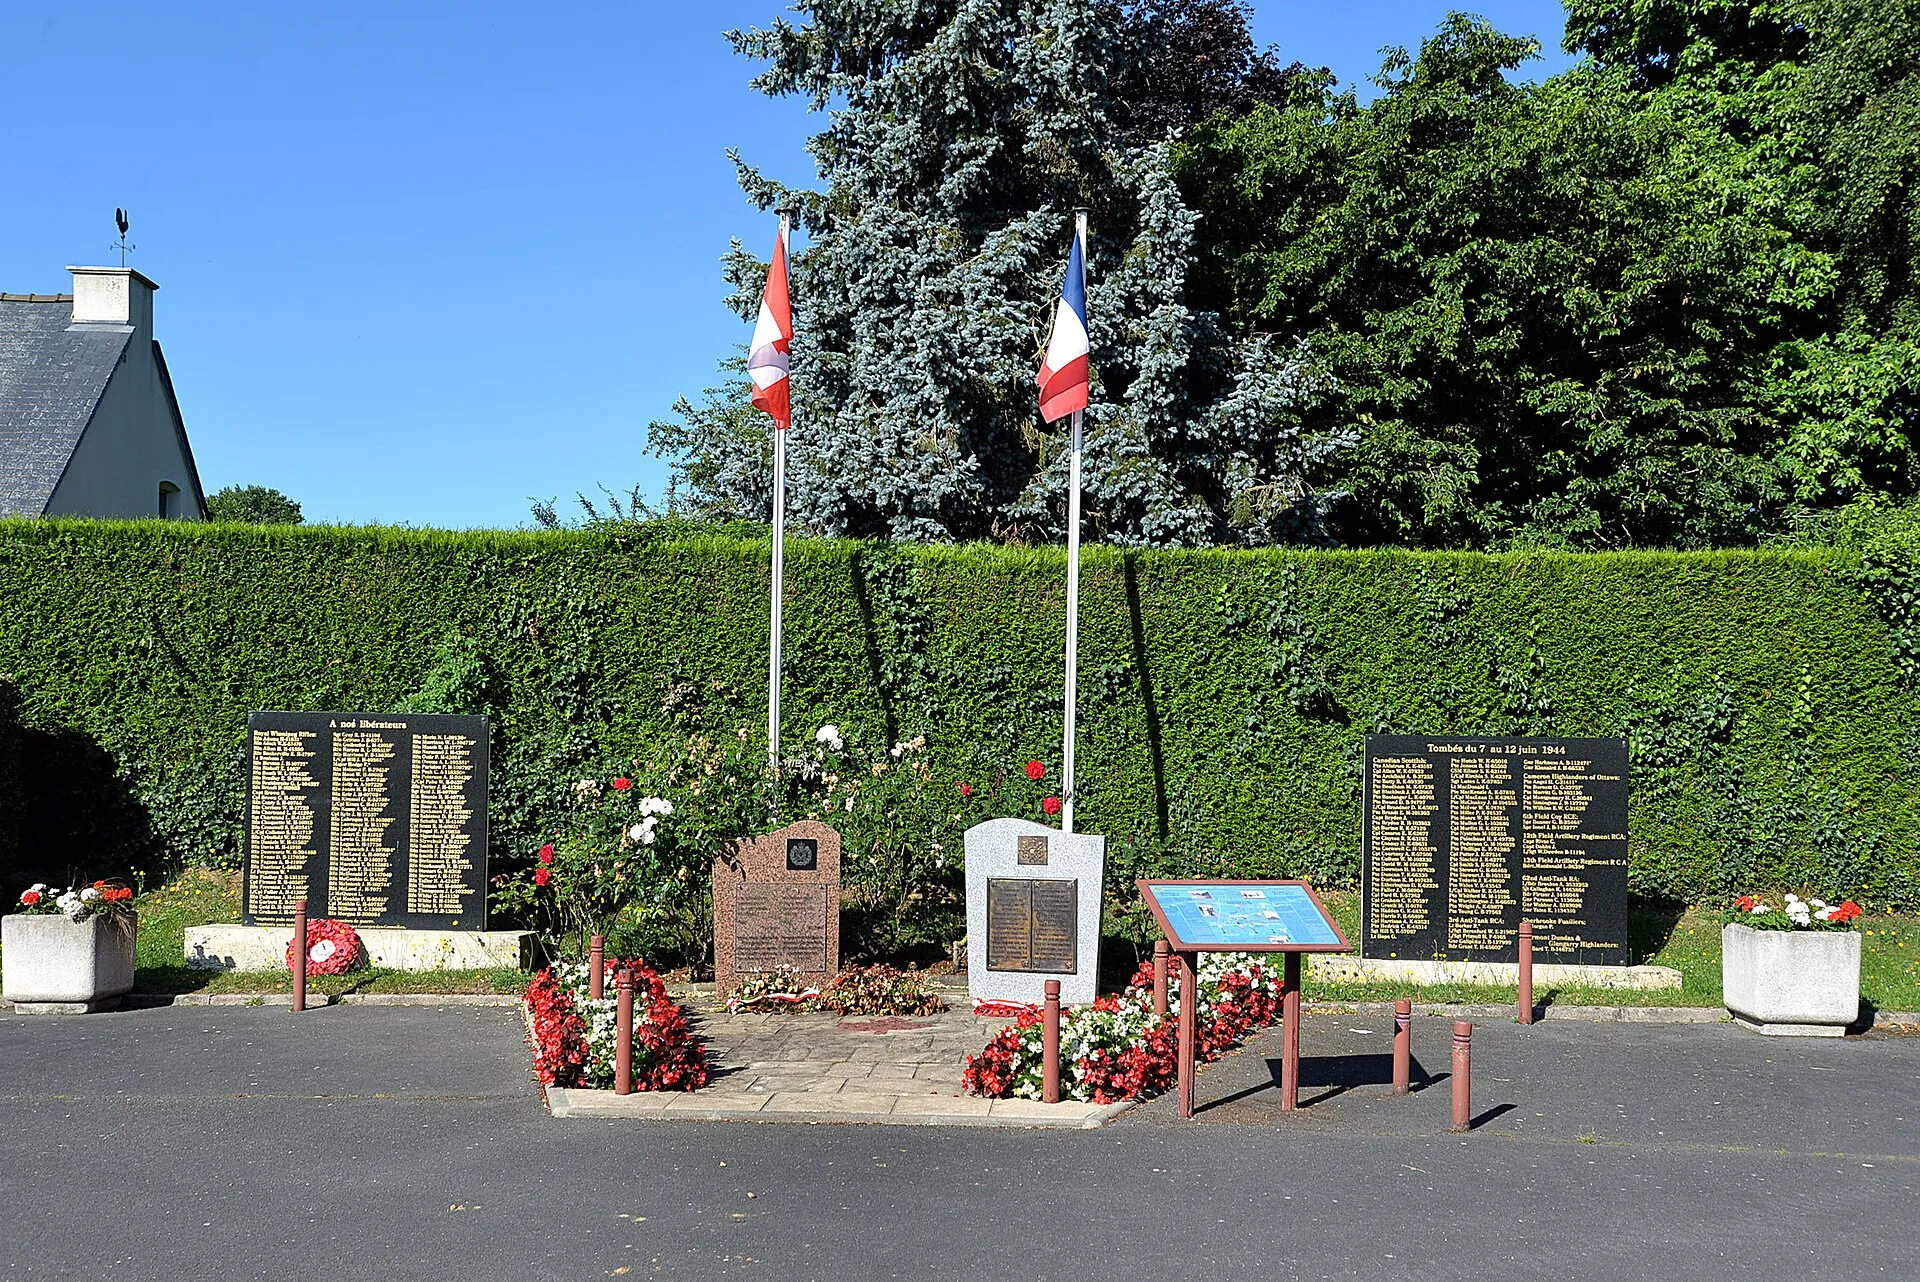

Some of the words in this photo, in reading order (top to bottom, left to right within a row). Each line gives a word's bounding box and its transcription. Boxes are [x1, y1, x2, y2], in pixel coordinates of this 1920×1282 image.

[330, 719, 336, 728] A
[341, 720, 356, 728] nos
[360, 720, 407, 729] libérateurs
[1428, 744, 1463, 753] Tombés
[1465, 744, 1477, 753] du
[1480, 745, 1485, 754] 7
[1490, 745, 1502, 754] au
[1505, 745, 1516, 754] 12
[1518, 745, 1537, 756] juin
[1543, 746, 1565, 755] 1944
[1555, 833, 1580, 841] Artillery
[1581, 833, 1610, 841] Regiment
